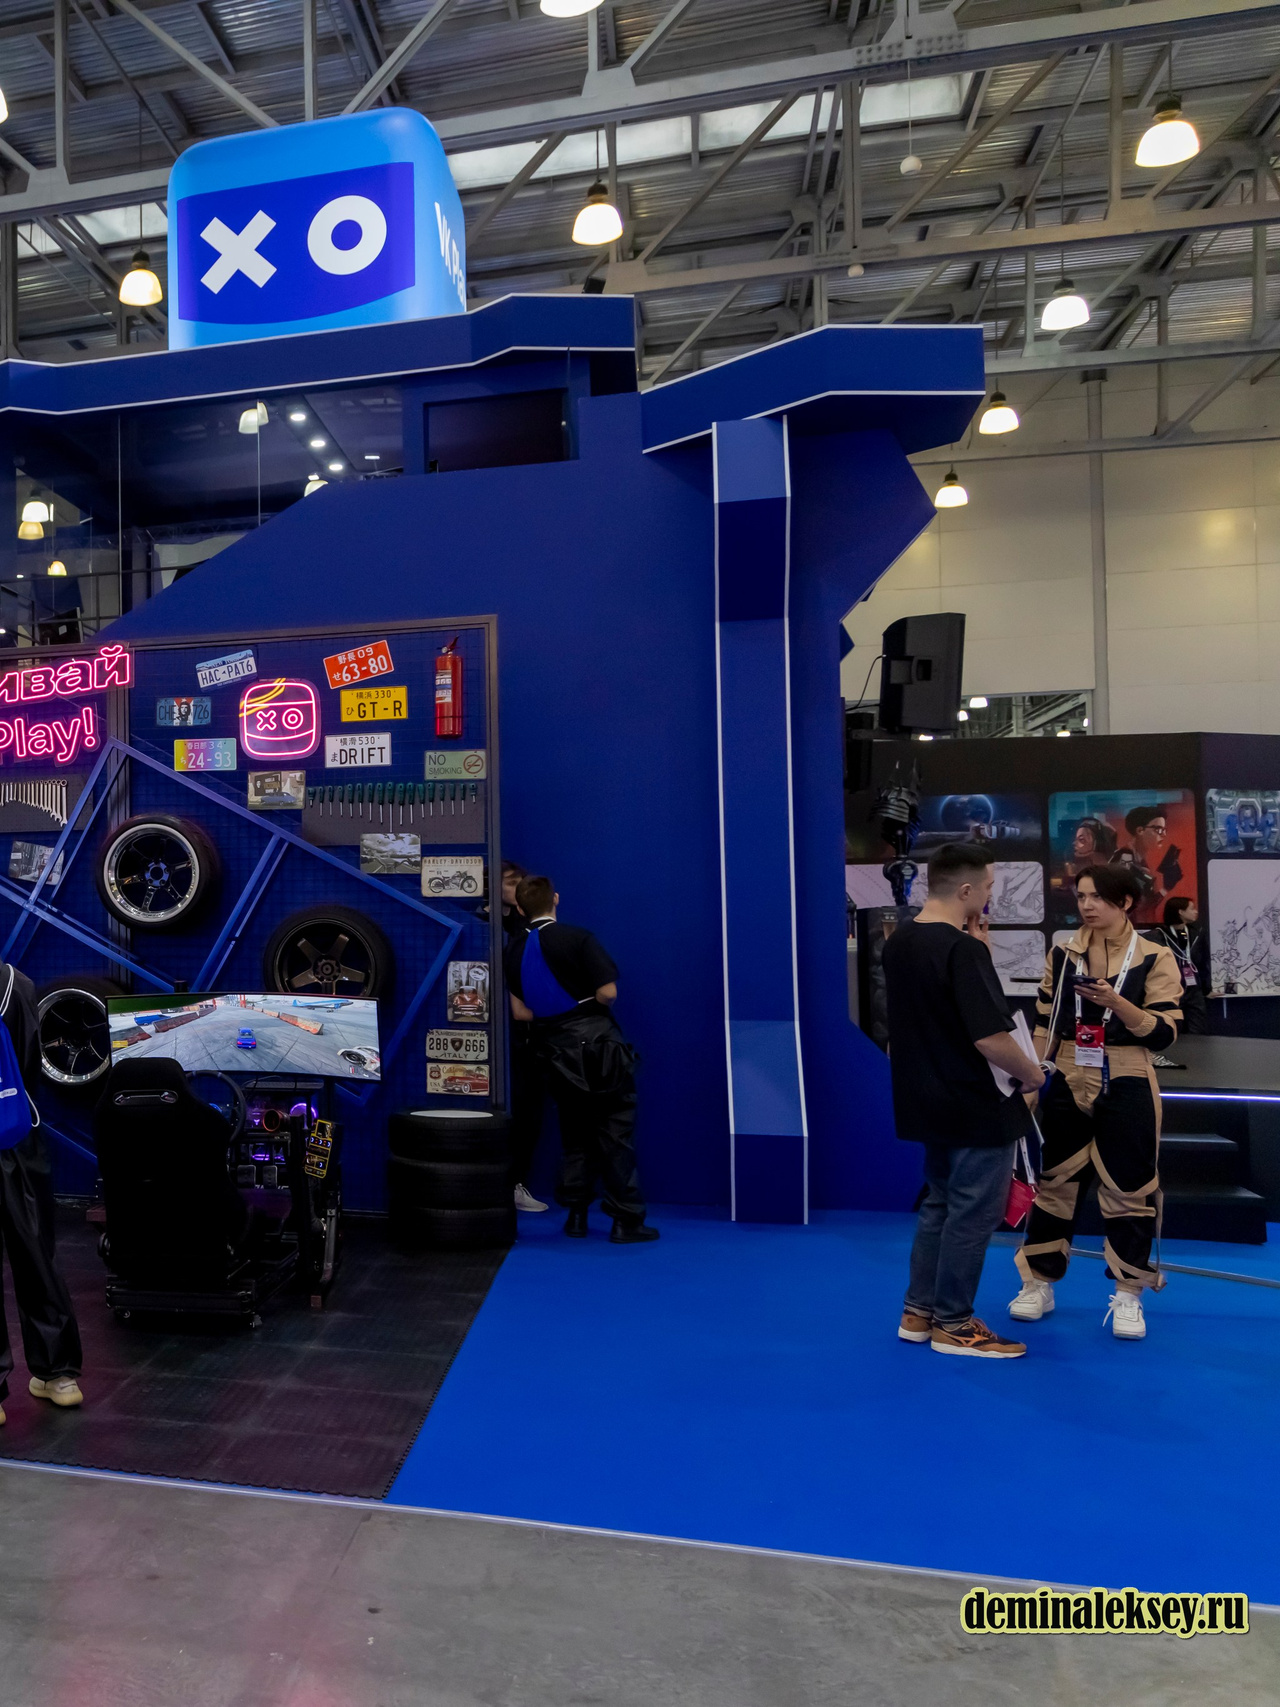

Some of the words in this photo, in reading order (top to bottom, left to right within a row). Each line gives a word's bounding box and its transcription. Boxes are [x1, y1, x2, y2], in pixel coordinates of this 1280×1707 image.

[434, 201, 452, 276] VK
[200, 669, 221, 685] HAC
[226, 660, 253, 678] PAT6
[341, 654, 388, 682] 63-80
[193, 704, 209, 720] 726
[187, 751, 232, 769] 24-93
[339, 746, 386, 765] DRIFT
[428, 754, 446, 765] NO
[428, 767, 462, 775] SMOKING
[428, 1037, 448, 1051] 288
[465, 1039, 485, 1052] 666
